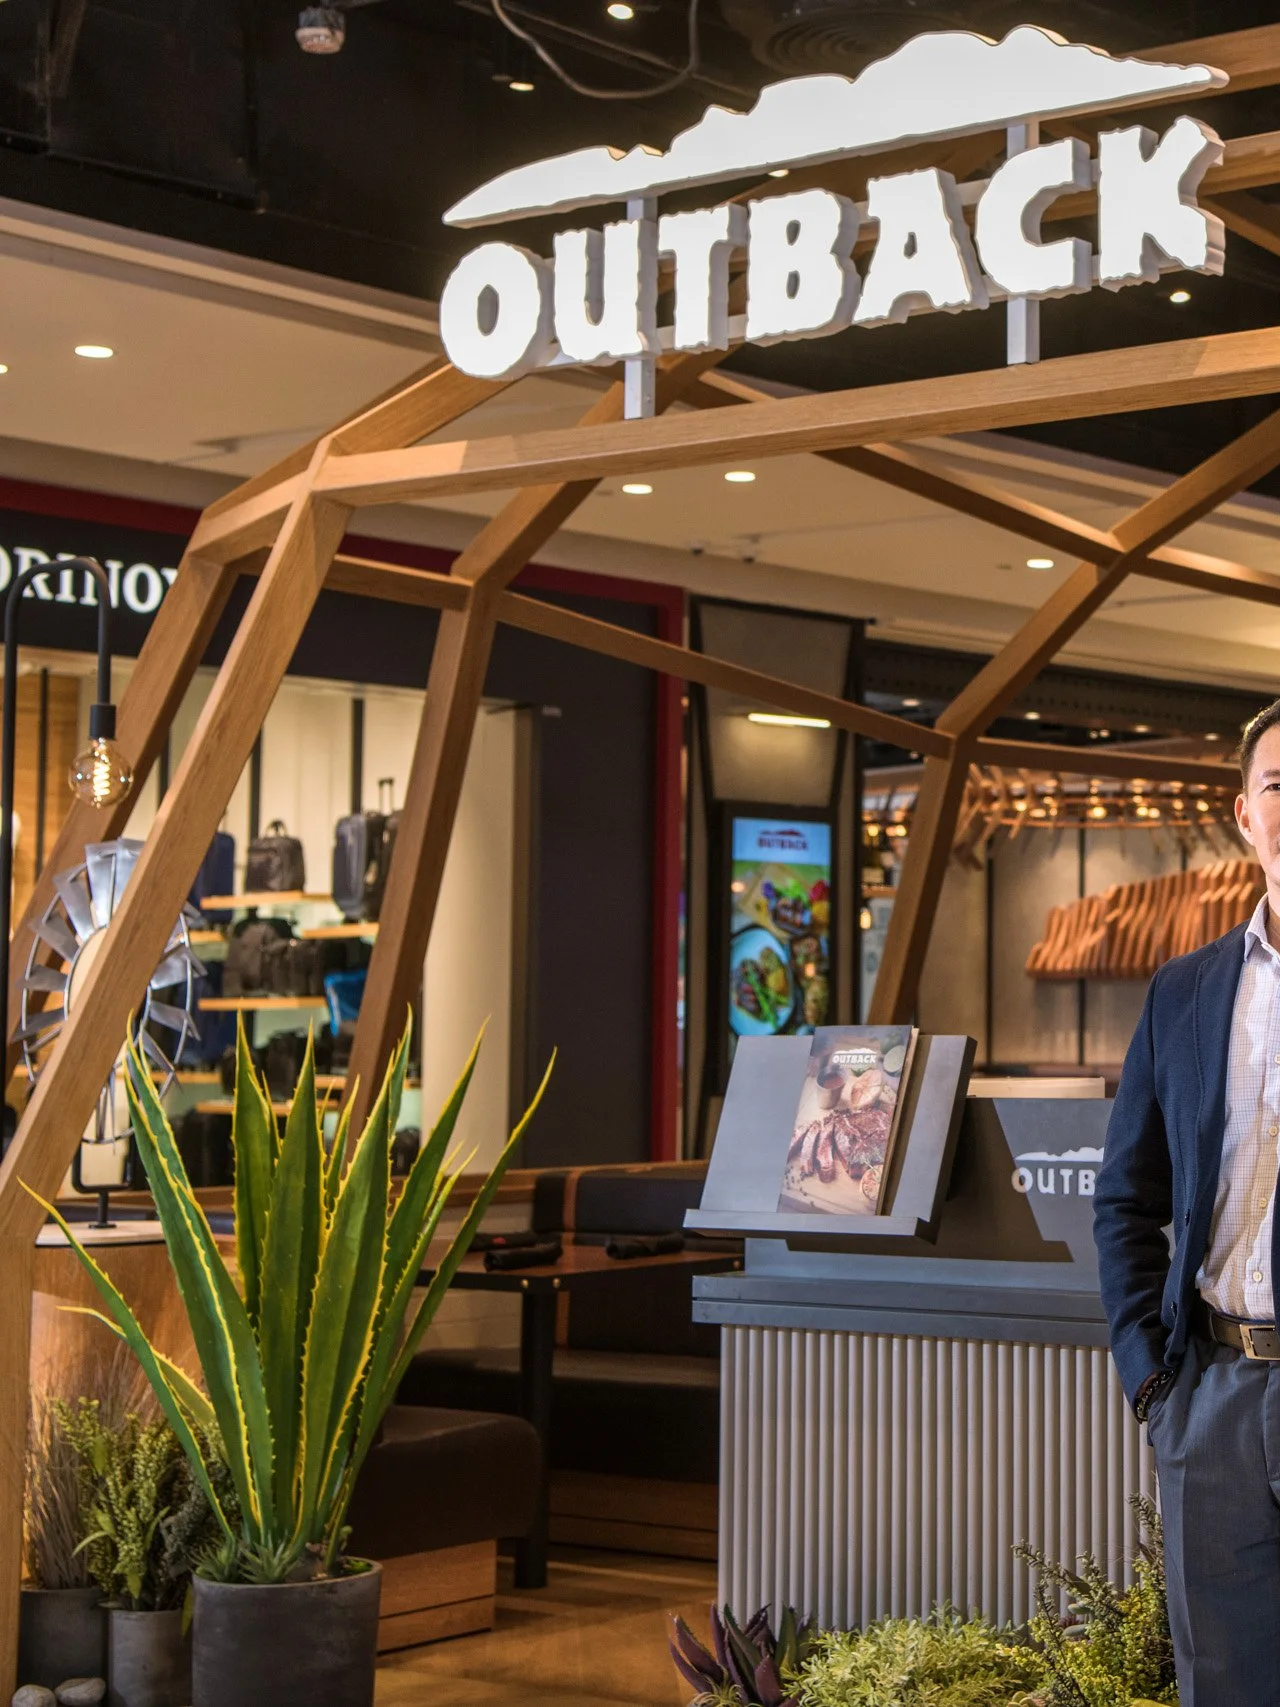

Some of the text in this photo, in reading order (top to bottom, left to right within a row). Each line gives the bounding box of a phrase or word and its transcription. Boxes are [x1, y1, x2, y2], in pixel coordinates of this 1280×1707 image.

[440, 114, 1226, 379] OUTBACK
[0, 545, 178, 614] RINO
[832, 1054, 877, 1064] OUTBACK
[1011, 1167, 1096, 1196] OUTB
